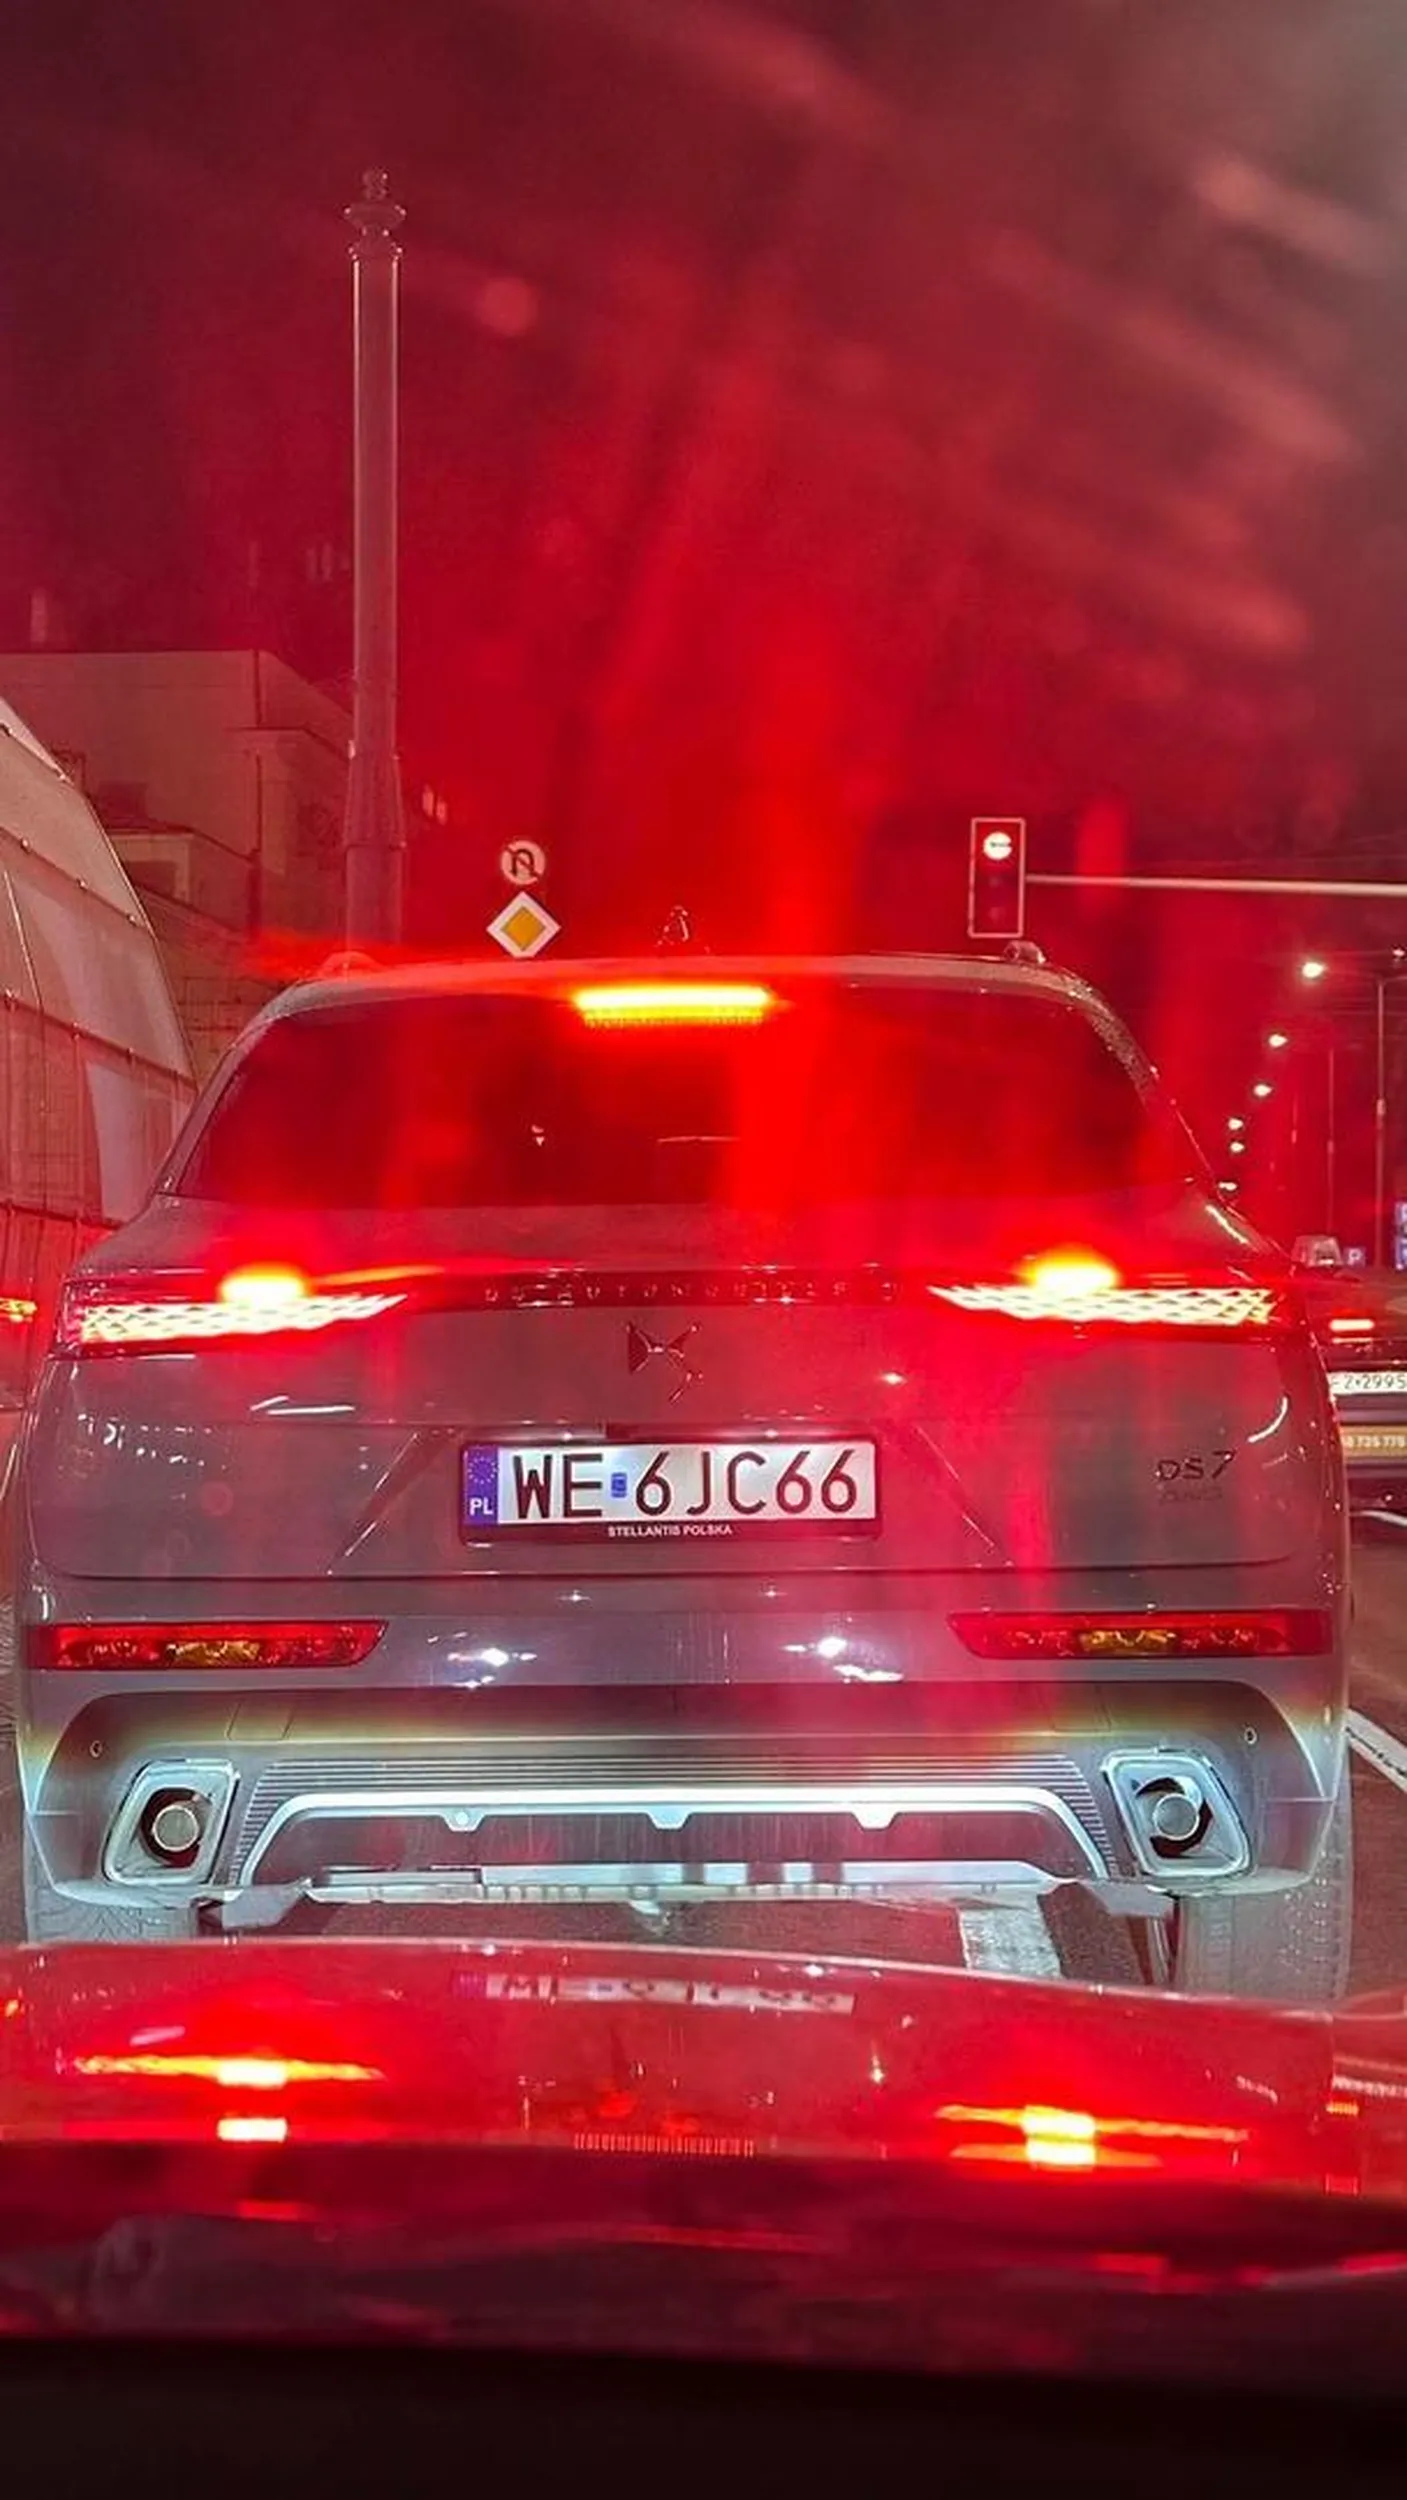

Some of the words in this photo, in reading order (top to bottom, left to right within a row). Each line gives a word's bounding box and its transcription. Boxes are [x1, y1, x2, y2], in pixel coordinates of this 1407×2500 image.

[512, 1453, 603, 1519] WE
[635, 1449, 857, 1517] 6JC66
[470, 1498, 494, 1516] PL
[608, 1525, 681, 1538] STELLANTIS
[683, 1524, 733, 1536] POLSKA
